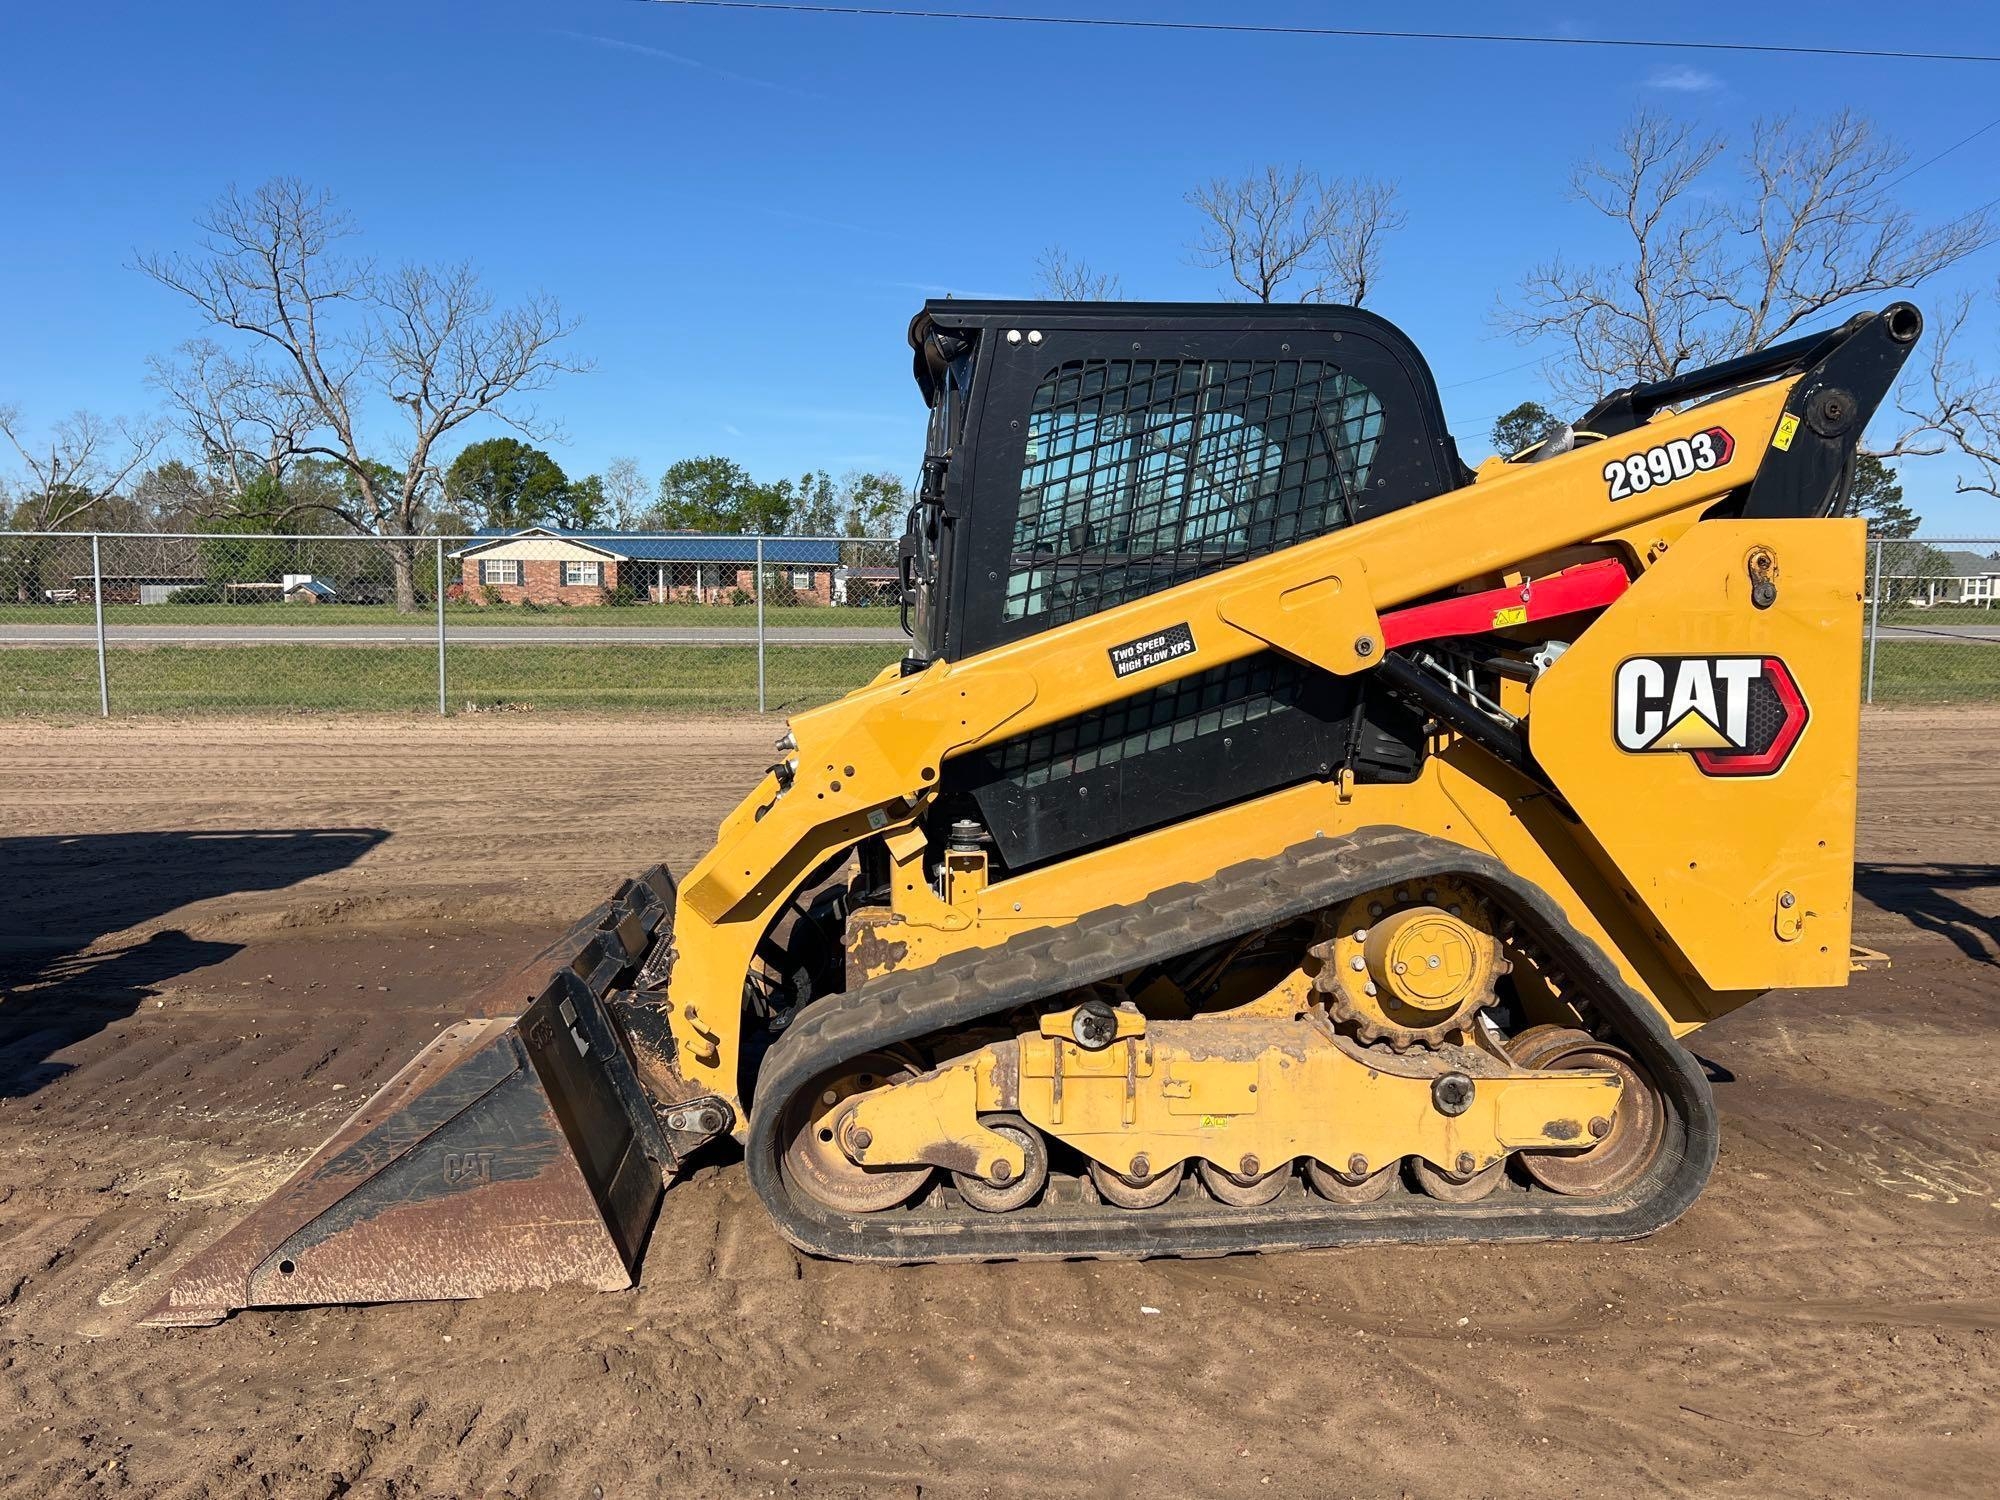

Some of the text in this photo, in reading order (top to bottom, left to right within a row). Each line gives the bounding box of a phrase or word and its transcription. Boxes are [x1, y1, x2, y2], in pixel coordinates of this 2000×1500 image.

[1605, 433, 1717, 500] 289D3
[1170, 640, 1191, 656] XPS
[1618, 658, 1762, 749] CAT
[444, 1153, 495, 1184] CAT
